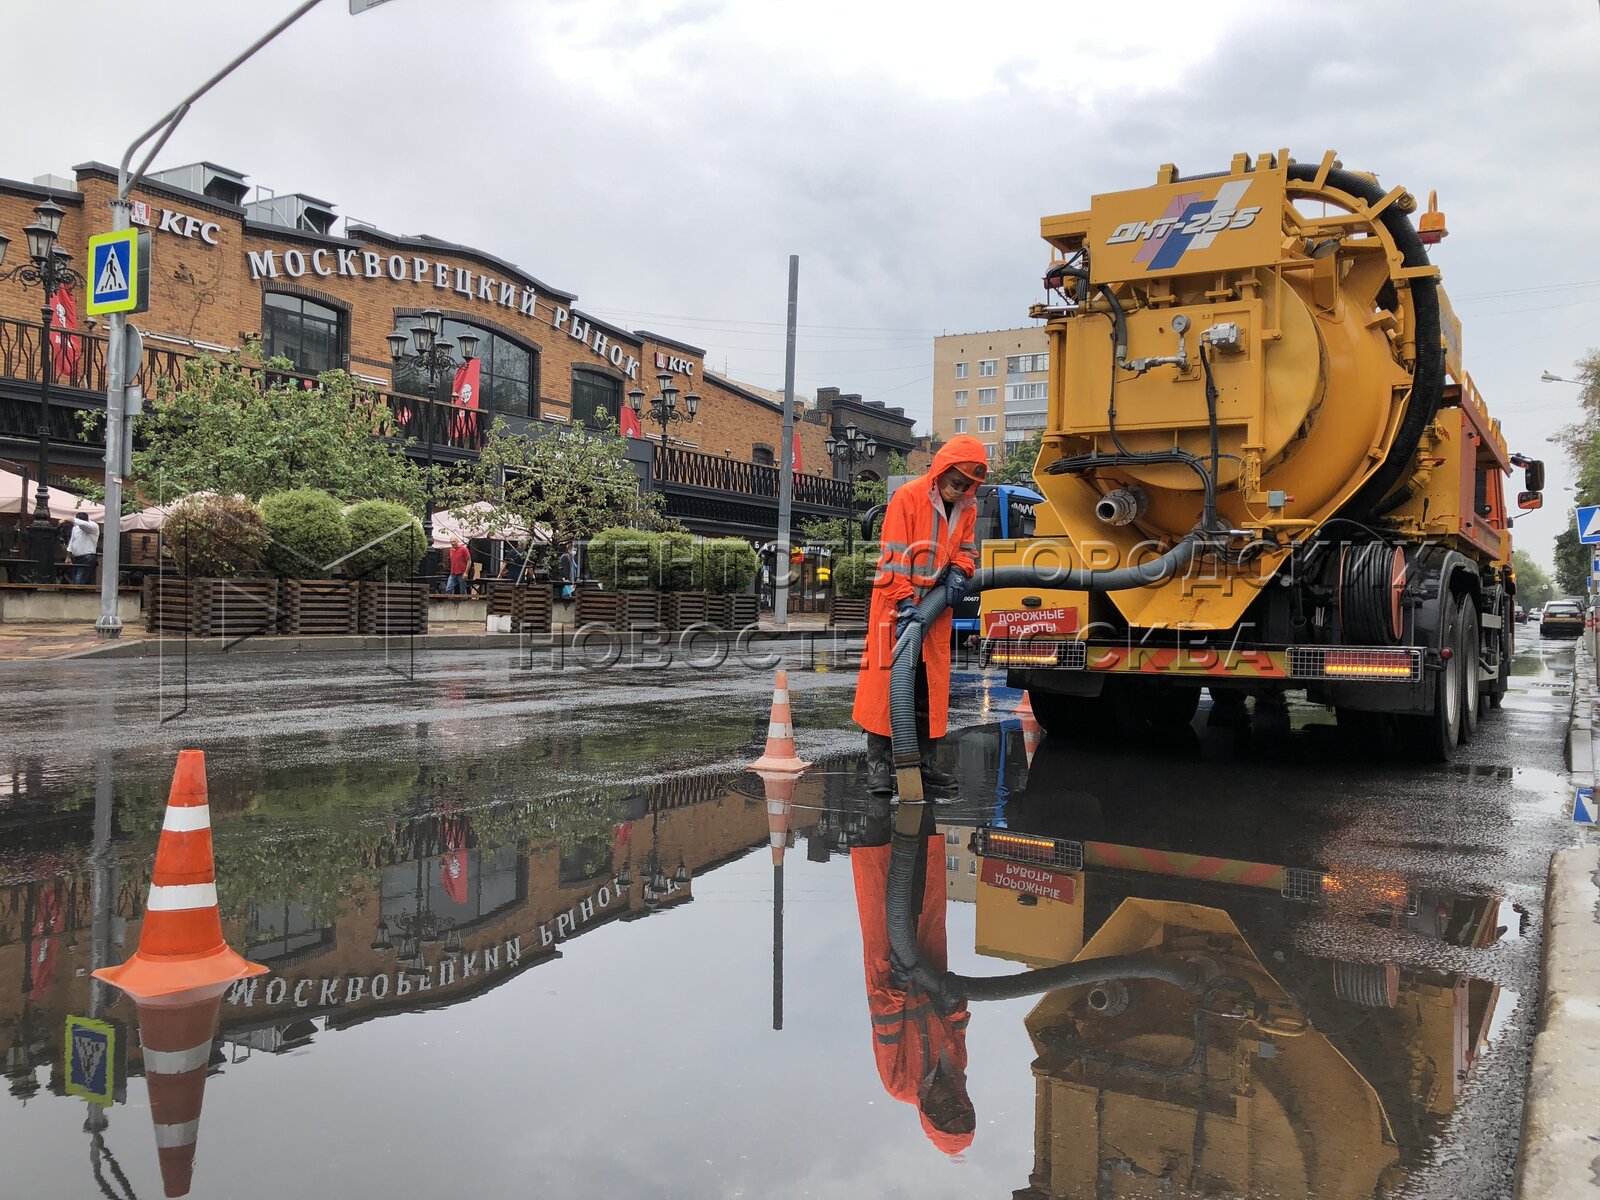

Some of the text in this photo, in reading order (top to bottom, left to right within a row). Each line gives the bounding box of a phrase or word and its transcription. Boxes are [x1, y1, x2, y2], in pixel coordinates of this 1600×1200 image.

[158, 209, 221, 246] KFC
[248, 248, 640, 381] МОСКВОРЕЦКИЙ РЫНОК
[668, 355, 695, 376] KFC
[998, 609, 1065, 625] ДОРОЖНЫЕ
[1009, 622, 1057, 635] РАБОТЫ
